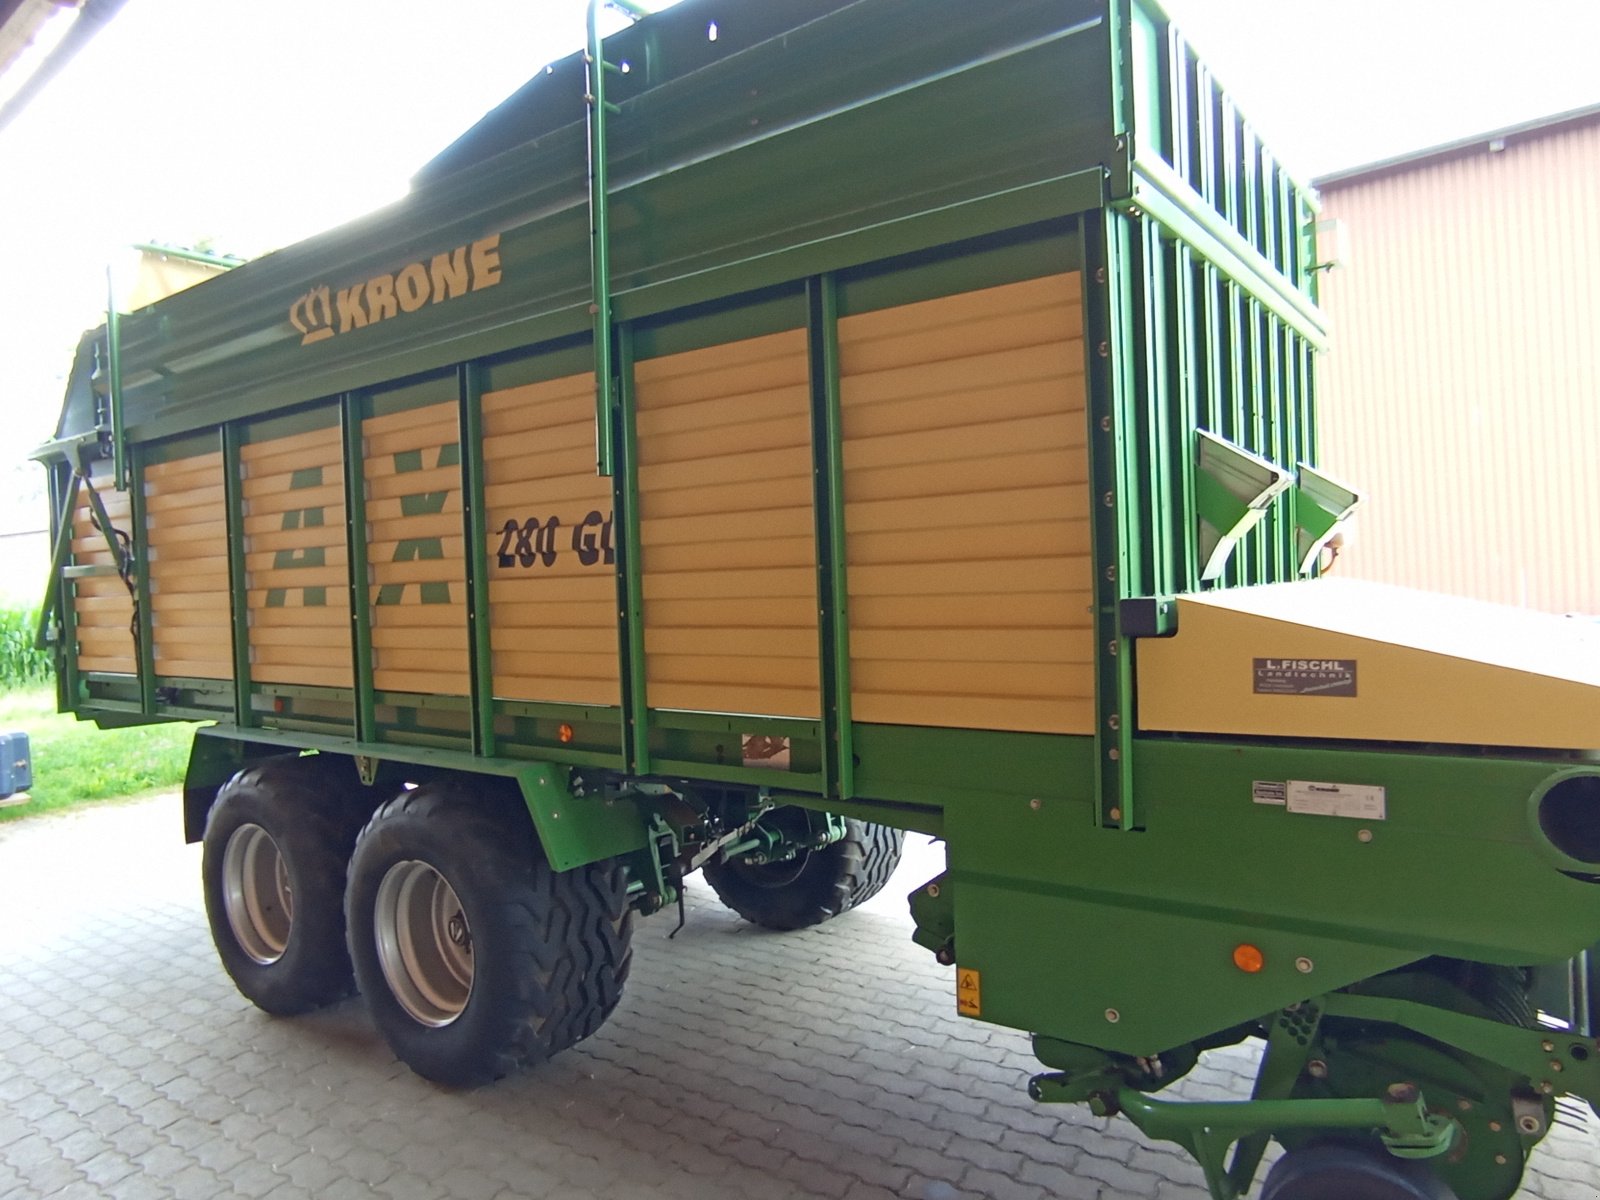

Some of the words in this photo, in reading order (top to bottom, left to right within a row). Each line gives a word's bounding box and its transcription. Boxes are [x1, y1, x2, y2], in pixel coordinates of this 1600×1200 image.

[336, 233, 502, 334] KRONE
[496, 515, 560, 568] 280
[1257, 670, 1351, 679] Landtechnik
